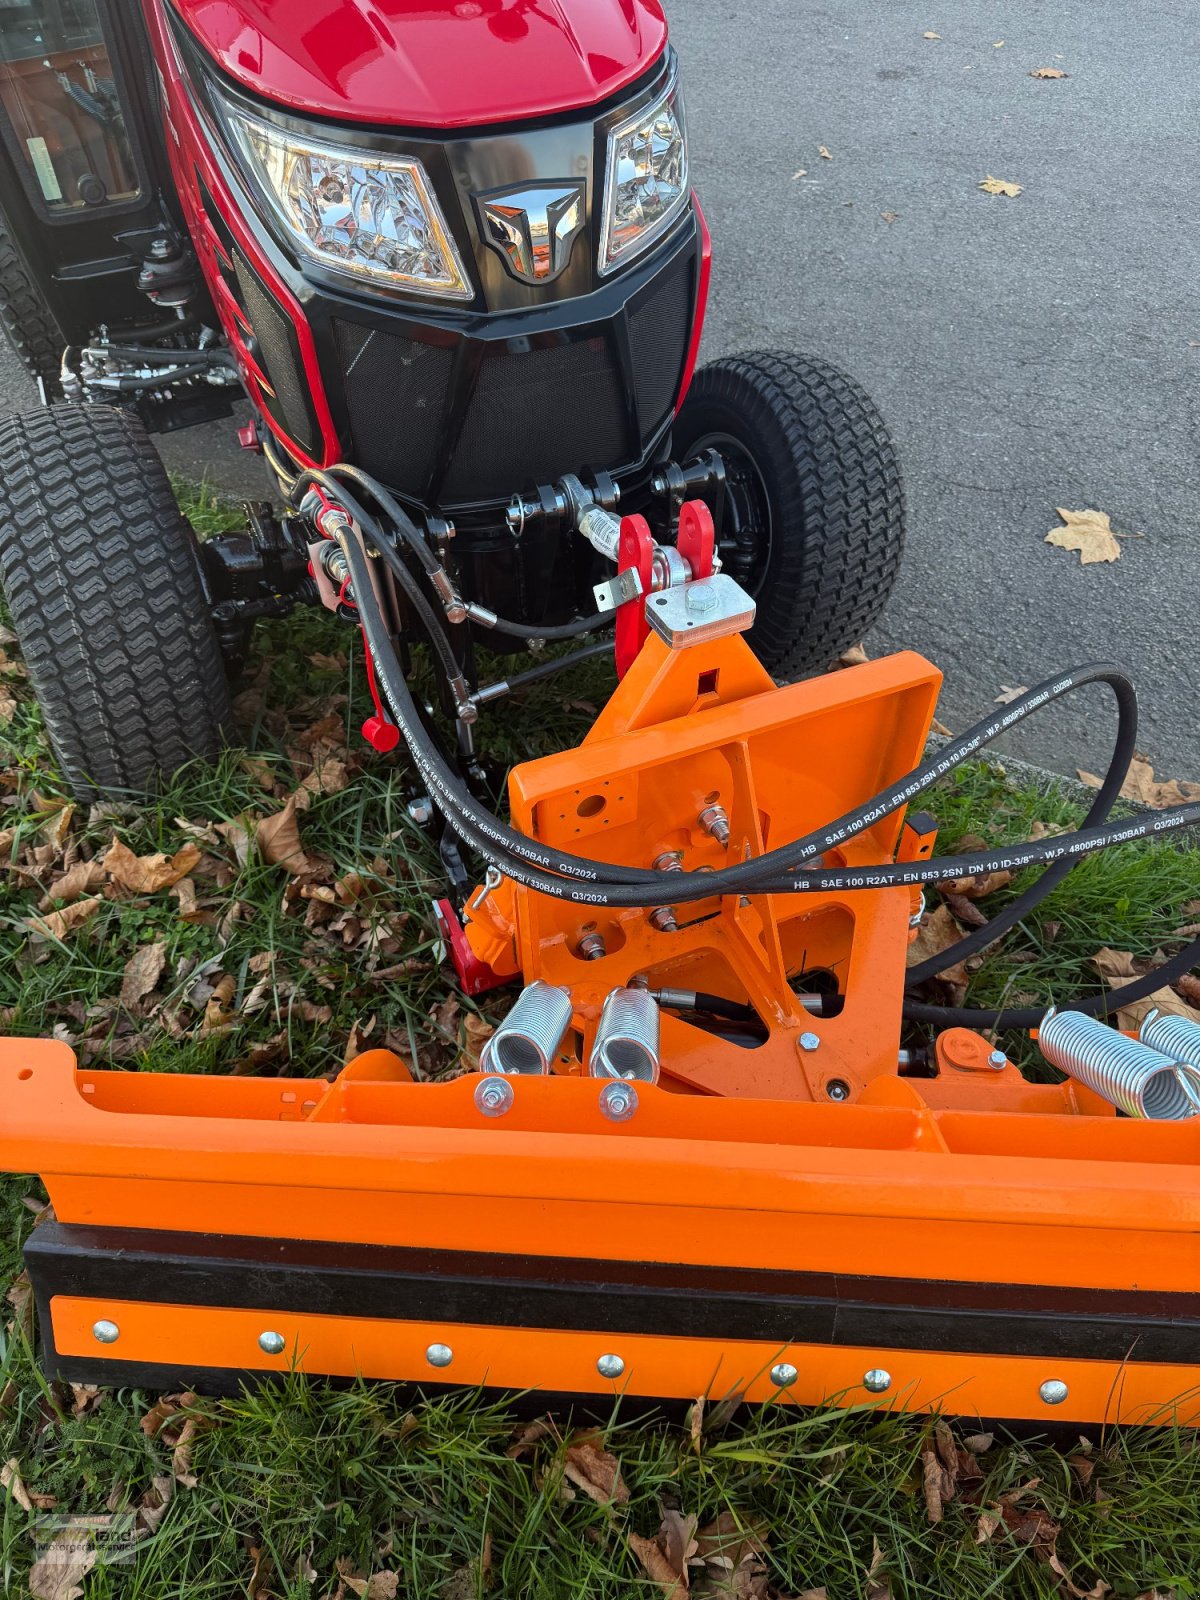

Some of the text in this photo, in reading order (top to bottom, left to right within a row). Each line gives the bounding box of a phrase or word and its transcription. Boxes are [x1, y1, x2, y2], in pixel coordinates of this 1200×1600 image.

[421, 759, 431, 772] DN
[430, 771, 438, 782] 10
[478, 823, 509, 847] 4800PSI
[515, 845, 550, 867] 330BAR
[559, 863, 597, 880] Q3/2024
[801, 844, 817, 857] HB
[825, 829, 846, 845] SAE
[847, 820, 863, 833] 100
[863, 803, 887, 824] R2AT
[892, 792, 906, 806] EN
[905, 782, 921, 796] 853
[920, 770, 937, 786] 2SN
[937, 760, 950, 773] DN
[950, 752, 960, 764] 10
[1002, 705, 1026, 727] 4800PSI
[1028, 691, 1050, 710] 330BAR
[1053, 678, 1073, 694] Q3/2024
[444, 810, 453, 822] DN
[452, 821, 459, 831] 10
[497, 863, 525, 882] 4800PSI
[530, 879, 563, 896] 330BAR
[571, 891, 608, 903] Q3/2024
[794, 881, 810, 889] HB
[821, 879, 843, 888] SAE
[846, 877, 864, 886] 100
[866, 875, 895, 885] R2AT
[903, 872, 919, 882] EN
[921, 870, 939, 880] 853
[941, 867, 963, 878] 2SN
[968, 864, 984, 874] DN
[986, 861, 999, 871] 10
[1069, 837, 1106, 854] 4800PSI
[1112, 826, 1147, 842] 330BAR
[1154, 816, 1184, 830] Q3/2024
